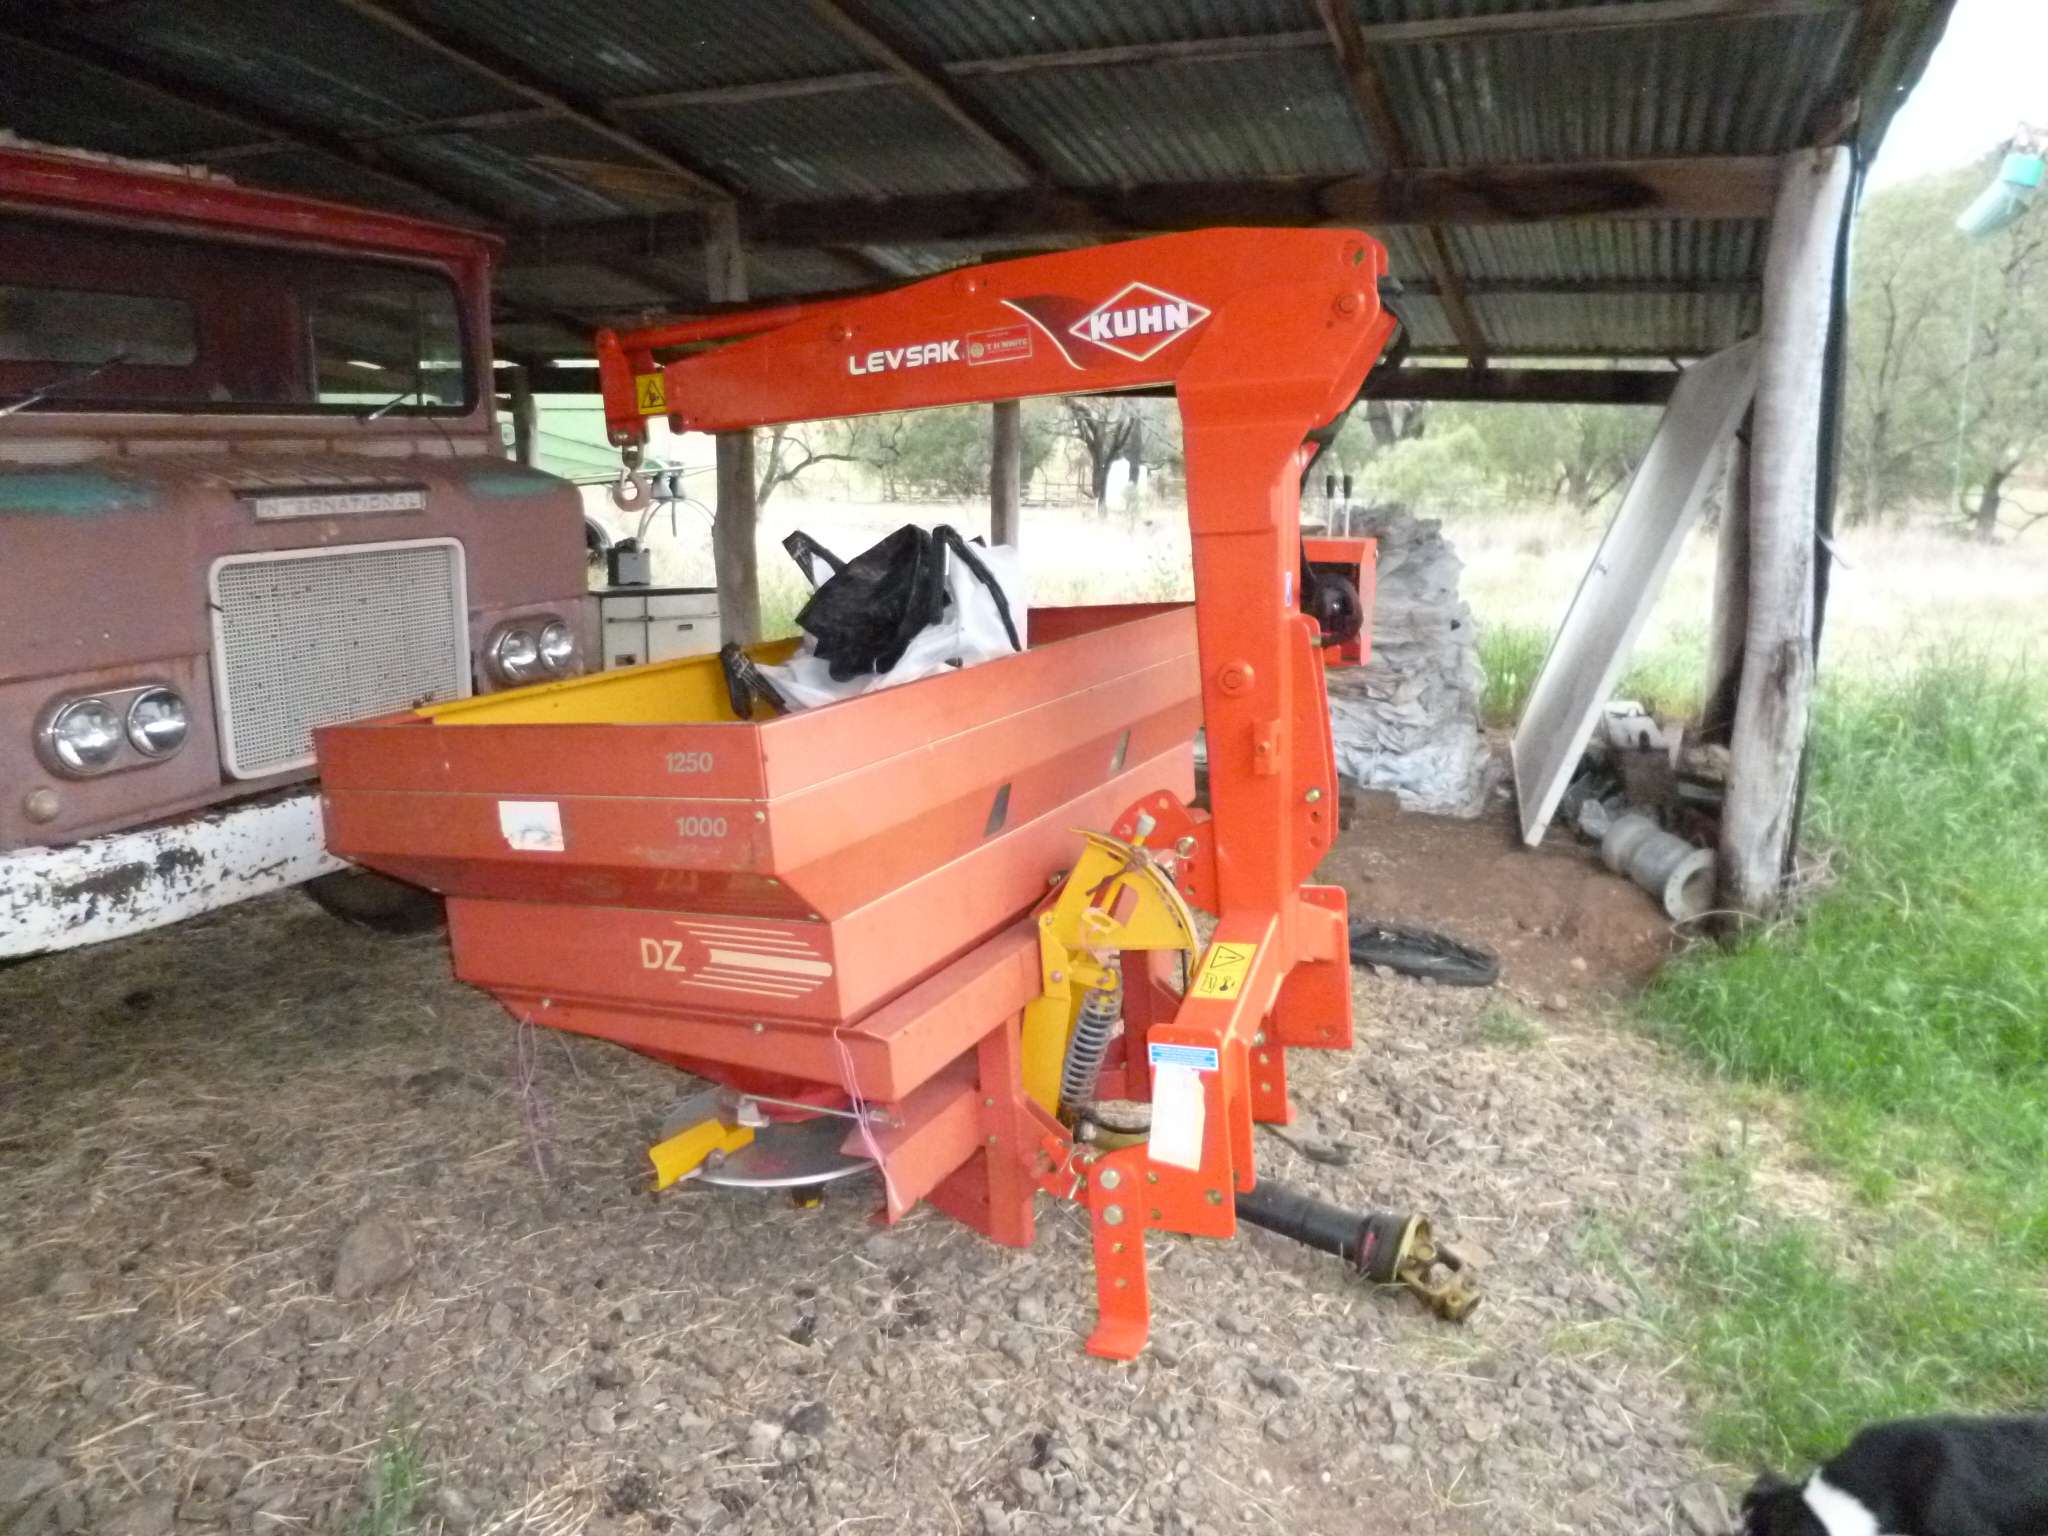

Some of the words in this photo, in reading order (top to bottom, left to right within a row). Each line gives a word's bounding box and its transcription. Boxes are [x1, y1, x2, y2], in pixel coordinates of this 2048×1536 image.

[1090, 303, 1189, 341] KUHN
[848, 340, 960, 375] LEVSAK
[666, 752, 713, 772] 1250
[677, 817, 727, 837] 1000
[640, 938, 686, 972] DZ
